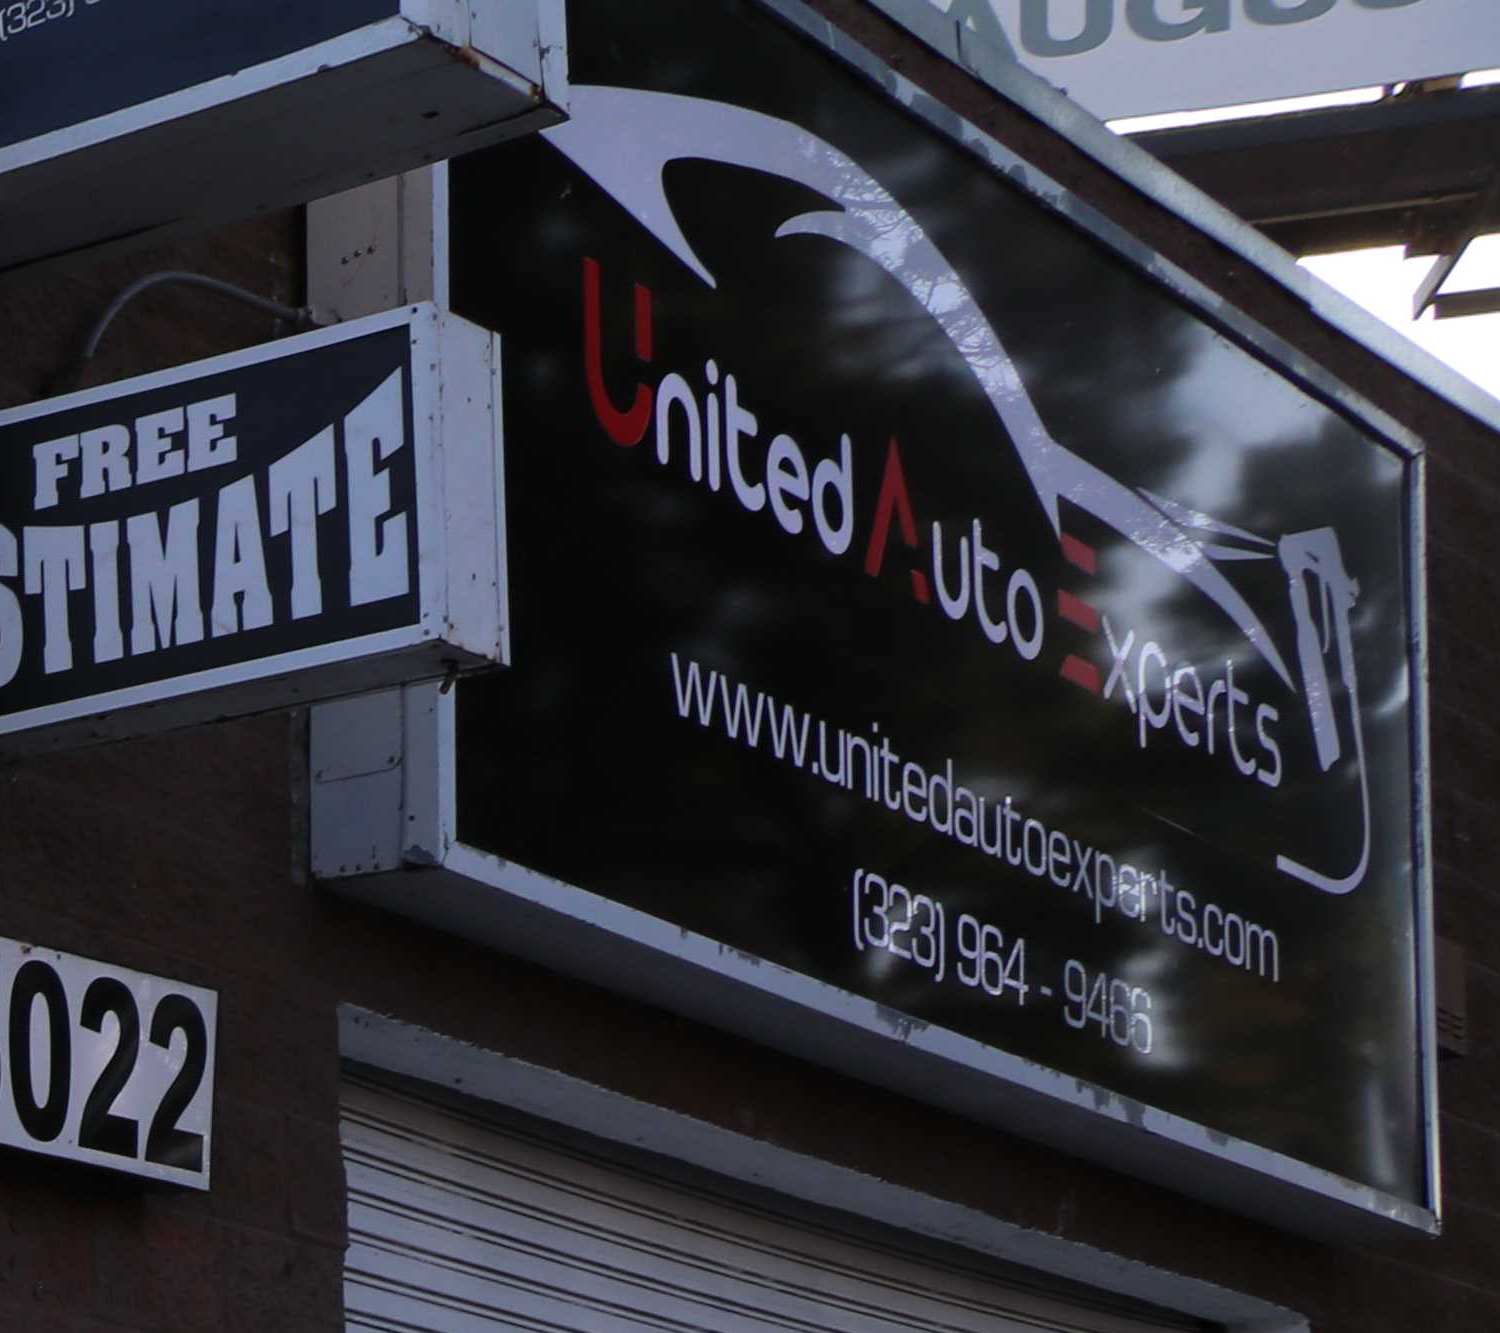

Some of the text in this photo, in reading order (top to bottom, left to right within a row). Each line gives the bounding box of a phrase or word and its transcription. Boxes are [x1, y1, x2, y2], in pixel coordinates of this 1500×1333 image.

[32, 393, 238, 511] FREE
[583, 257, 1283, 788] United Auto Experts
[670, 652, 1280, 982] www.unitedautoexperts.com
[853, 868, 945, 982] (323)
[956, 913, 1029, 1006] 964
[1063, 959, 1153, 1054] 9466
